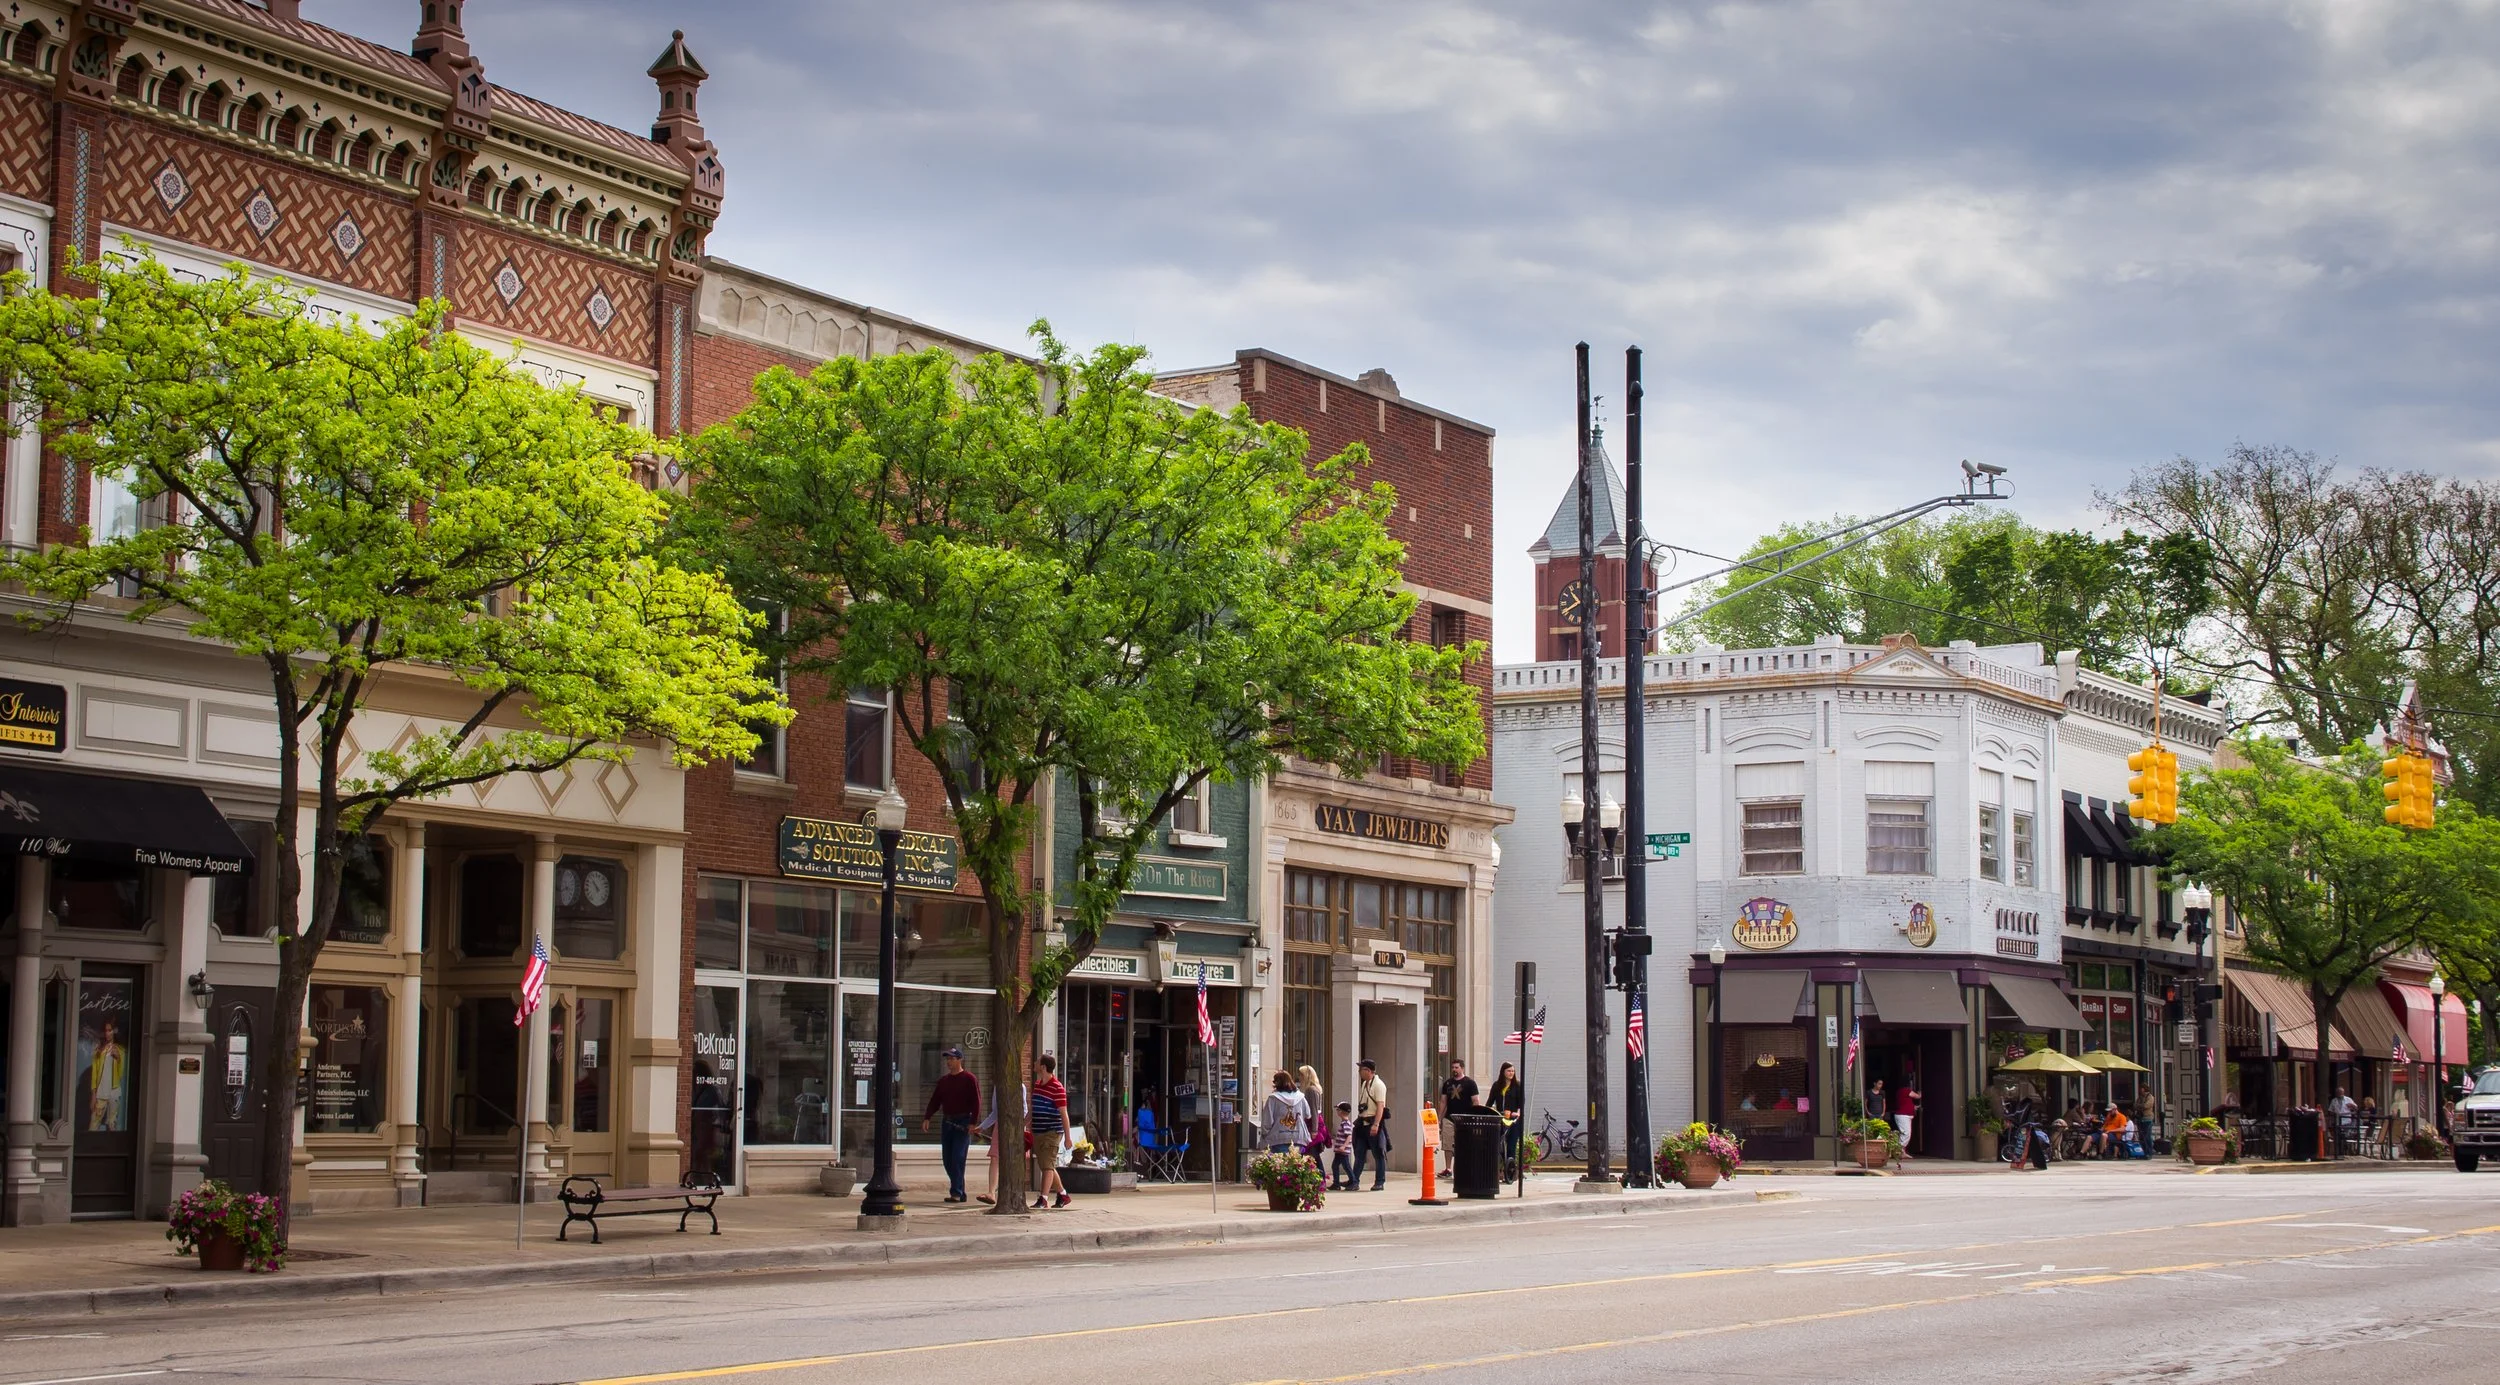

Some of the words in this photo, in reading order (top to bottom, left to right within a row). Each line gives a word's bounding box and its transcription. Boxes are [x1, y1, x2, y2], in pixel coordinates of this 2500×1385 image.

[0, 693, 61, 725] Interiors
[0, 728, 25, 740] IFTS
[1273, 803, 1298, 820] 1865
[866, 815, 876, 827] 10
[1322, 805, 1357, 834] YAX
[1365, 813, 1449, 848] JEWELERS
[19, 838, 43, 852] 110
[793, 821, 875, 846] ADVANCED
[896, 833, 949, 855] EDICAL
[1467, 831, 1485, 848] 1915
[1655, 835, 1681, 843] MICHIGAN
[135, 849, 157, 864] Fine
[160, 851, 201, 869] Womens
[204, 856, 242, 873] Apparel
[813, 844, 898, 871] SOLUTION,
[904, 854, 932, 874] INC.
[896, 873, 904, 881] &
[1145, 865, 1162, 885] On
[1165, 867, 1185, 886] The
[1190, 870, 1217, 889] River
[363, 914, 381, 928] 108
[359, 931, 381, 943] Gran
[1739, 924, 1791, 936] UPTOWN
[1074, 956, 1130, 973] ollectibles
[1378, 952, 1390, 965] 102
[1176, 962, 1225, 979] Treaures
[697, 1032, 736, 1055] DeKroub
[964, 1030, 991, 1046] OPEN
[719, 1055, 735, 1071] Team
[340, 1071, 353, 1079] PLC
[1175, 1084, 1195, 1096] OPEN
